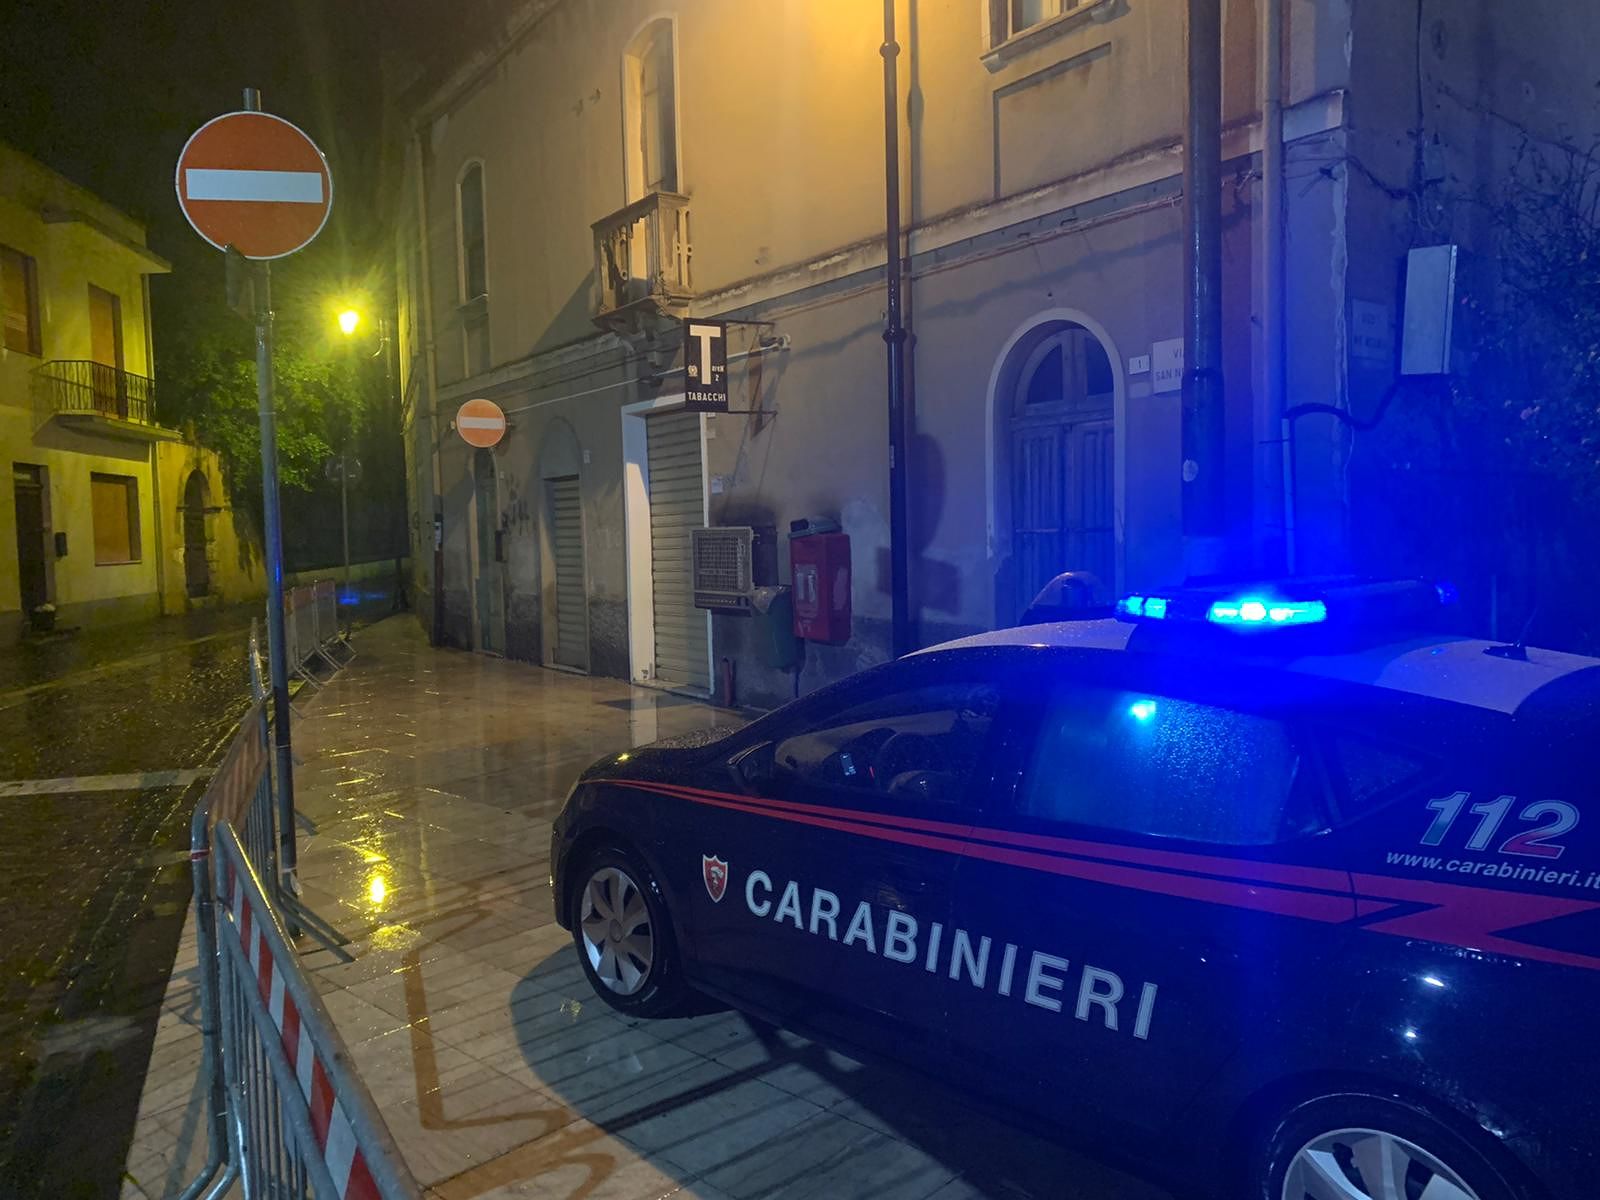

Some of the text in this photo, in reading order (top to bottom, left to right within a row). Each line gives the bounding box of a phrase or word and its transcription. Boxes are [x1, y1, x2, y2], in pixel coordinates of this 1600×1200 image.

[690, 324, 721, 385] T
[1173, 348, 1182, 358] VI
[688, 391, 726, 402] TABACCHI
[1420, 791, 1580, 859] 112
[1386, 852, 1600, 889] www.carabinieri.it
[745, 870, 1157, 1040] CARABINIERI
